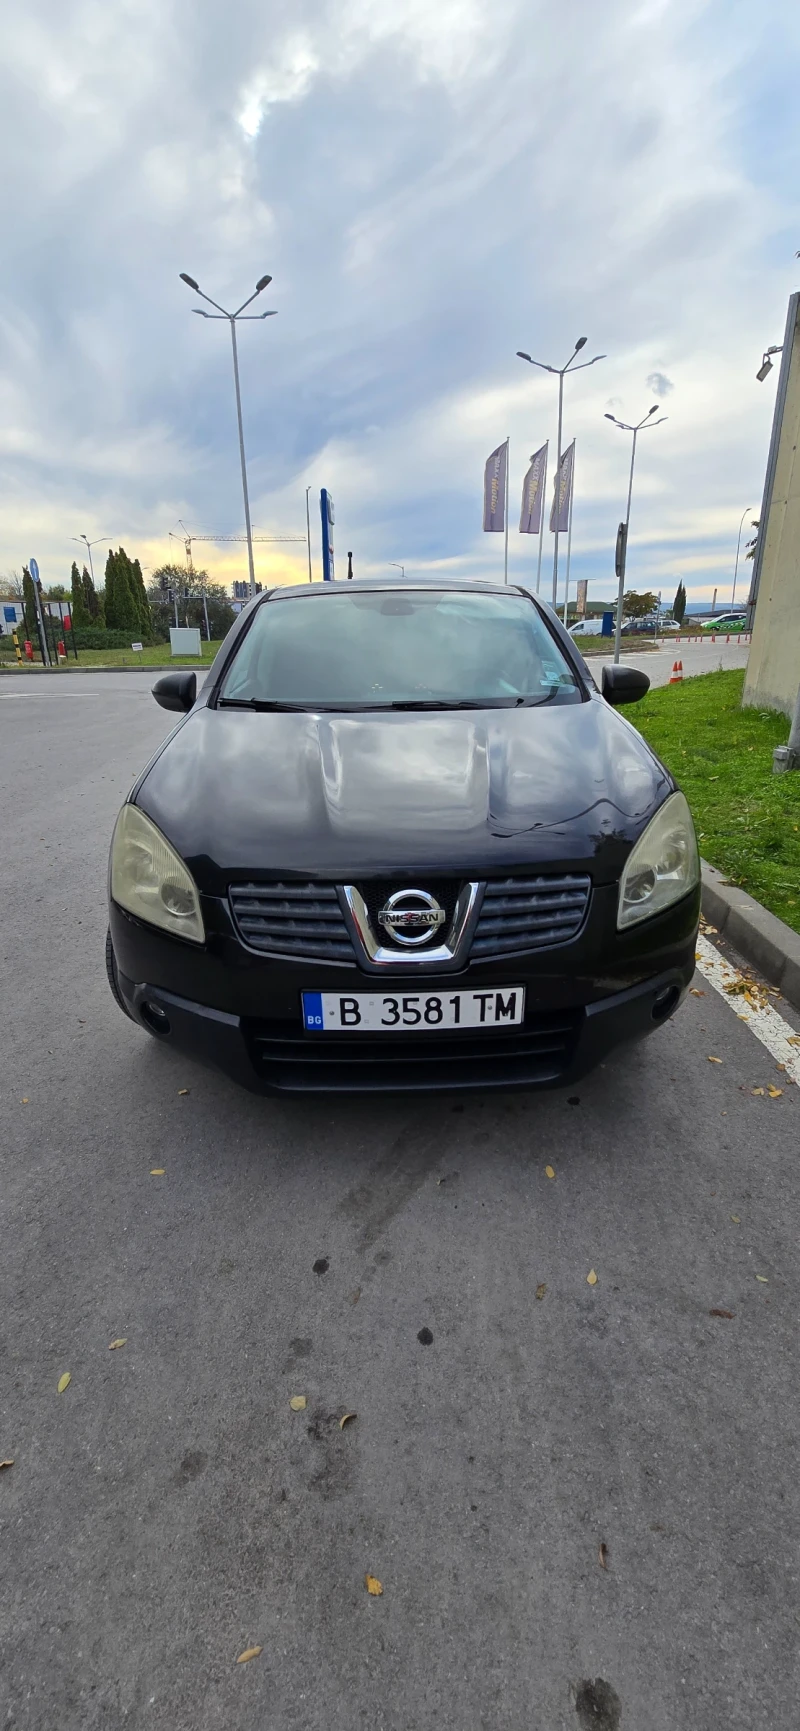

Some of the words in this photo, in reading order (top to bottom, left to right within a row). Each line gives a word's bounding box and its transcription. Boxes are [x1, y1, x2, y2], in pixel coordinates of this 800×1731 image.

[532, 457, 541, 480] MAXX
[490, 478, 499, 514] Motion
[385, 913, 439, 924] NISSAN
[307, 1015, 321, 1025] BG
[339, 997, 361, 1026] B
[381, 995, 461, 1025] 3581
[473, 992, 517, 1022] TM
